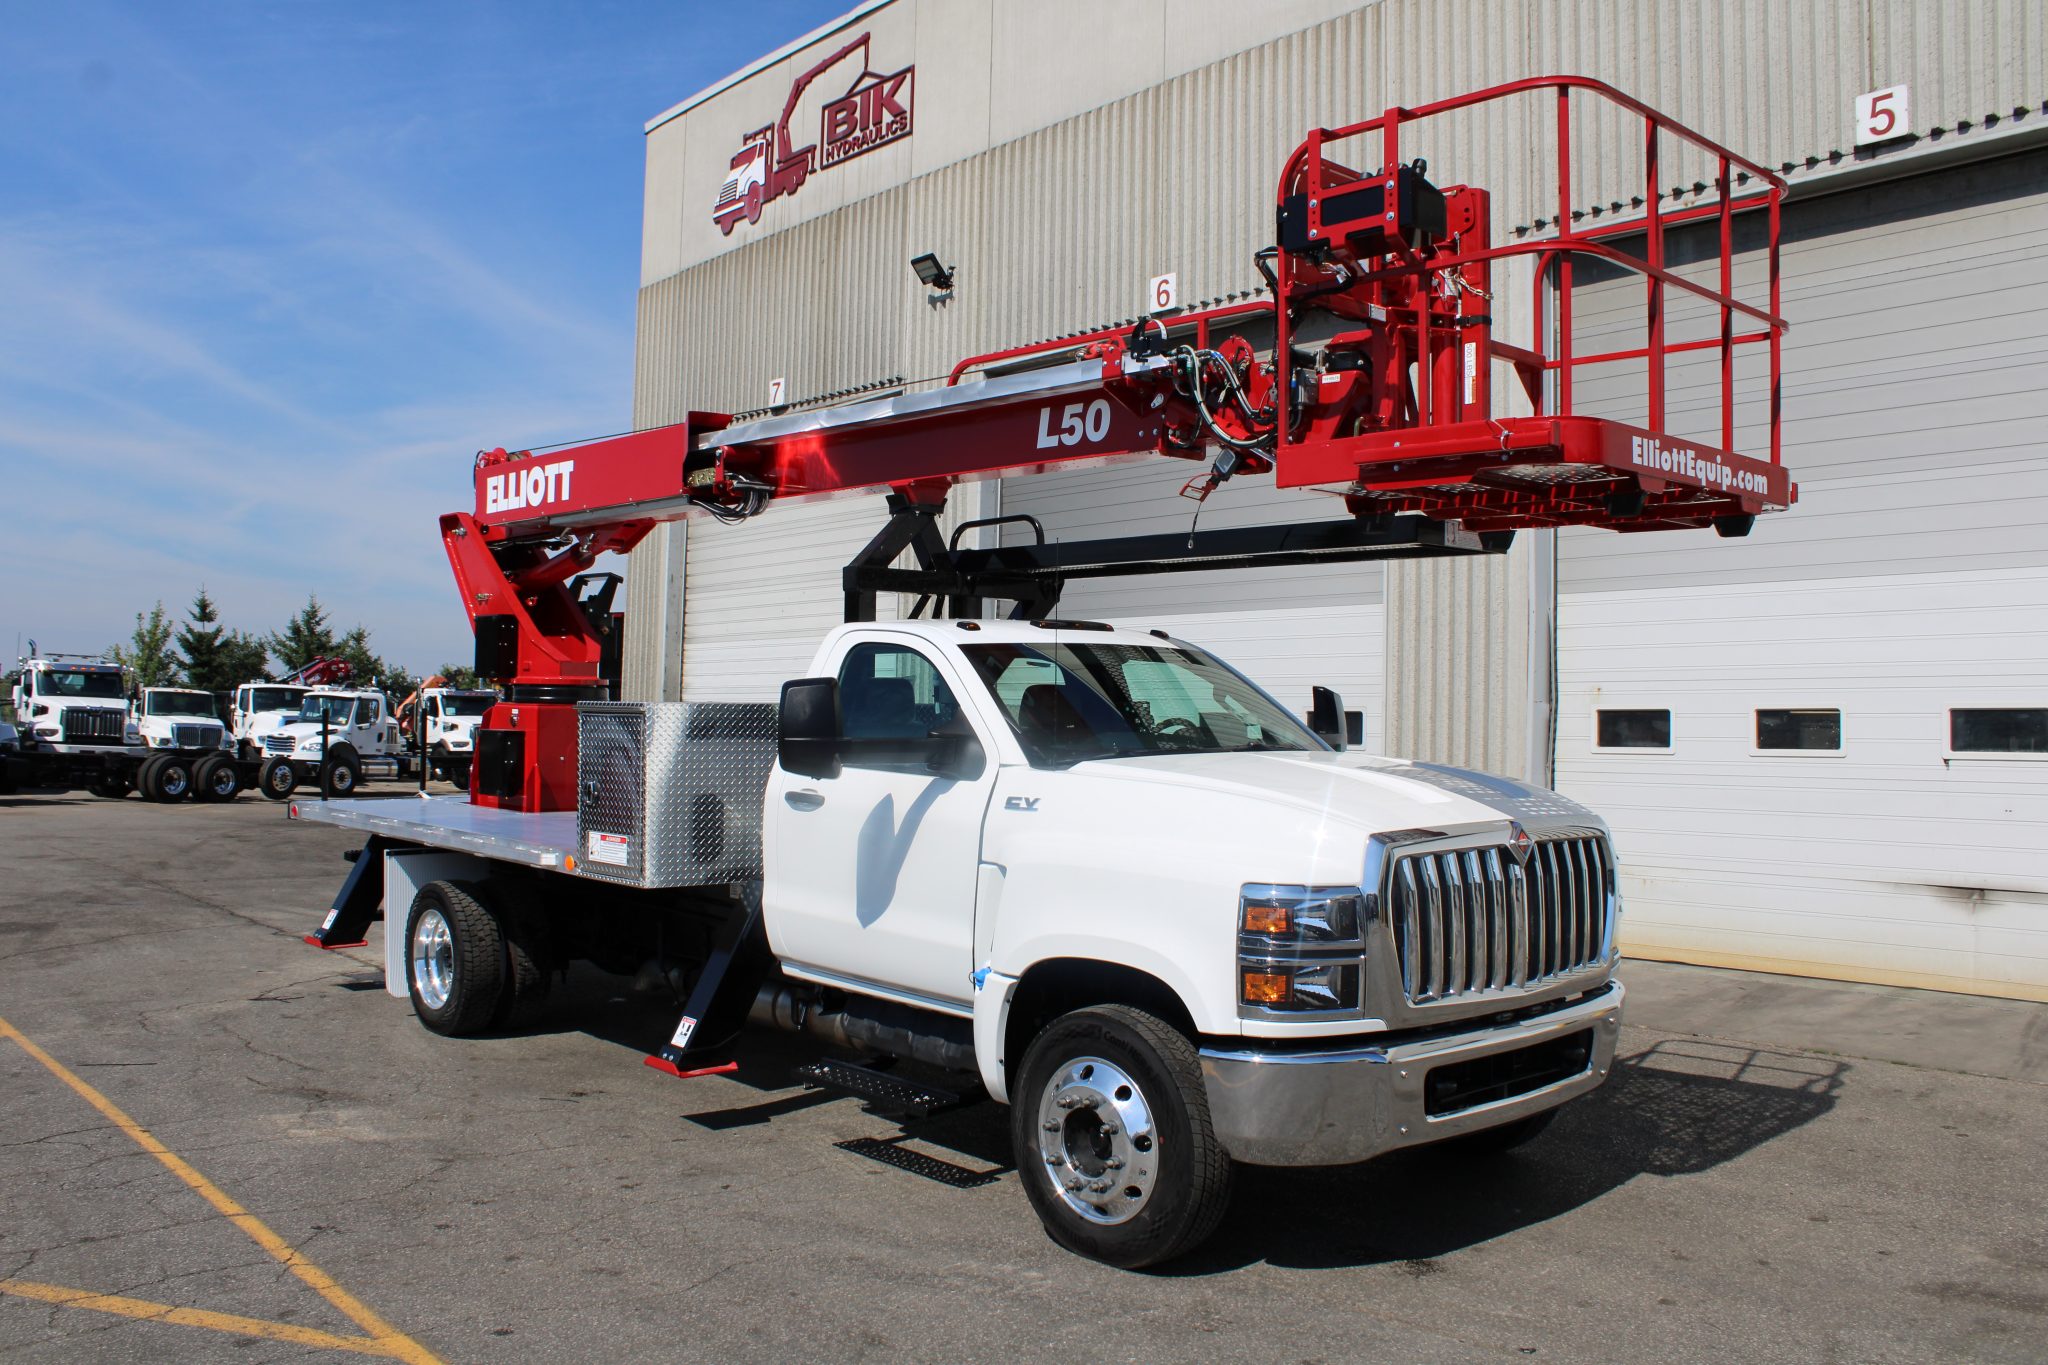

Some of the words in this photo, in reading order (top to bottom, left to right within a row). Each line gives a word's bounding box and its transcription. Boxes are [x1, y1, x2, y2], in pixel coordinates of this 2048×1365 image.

[1869, 92, 1895, 136] 5
[825, 115, 908, 163] HYDRAULICS
[1155, 279, 1170, 308] 6
[772, 382, 781, 404] 7
[1036, 399, 1111, 449] L50
[486, 460, 574, 514] ELLIOTT
[1632, 435, 1768, 495] ElliottEquip.com
